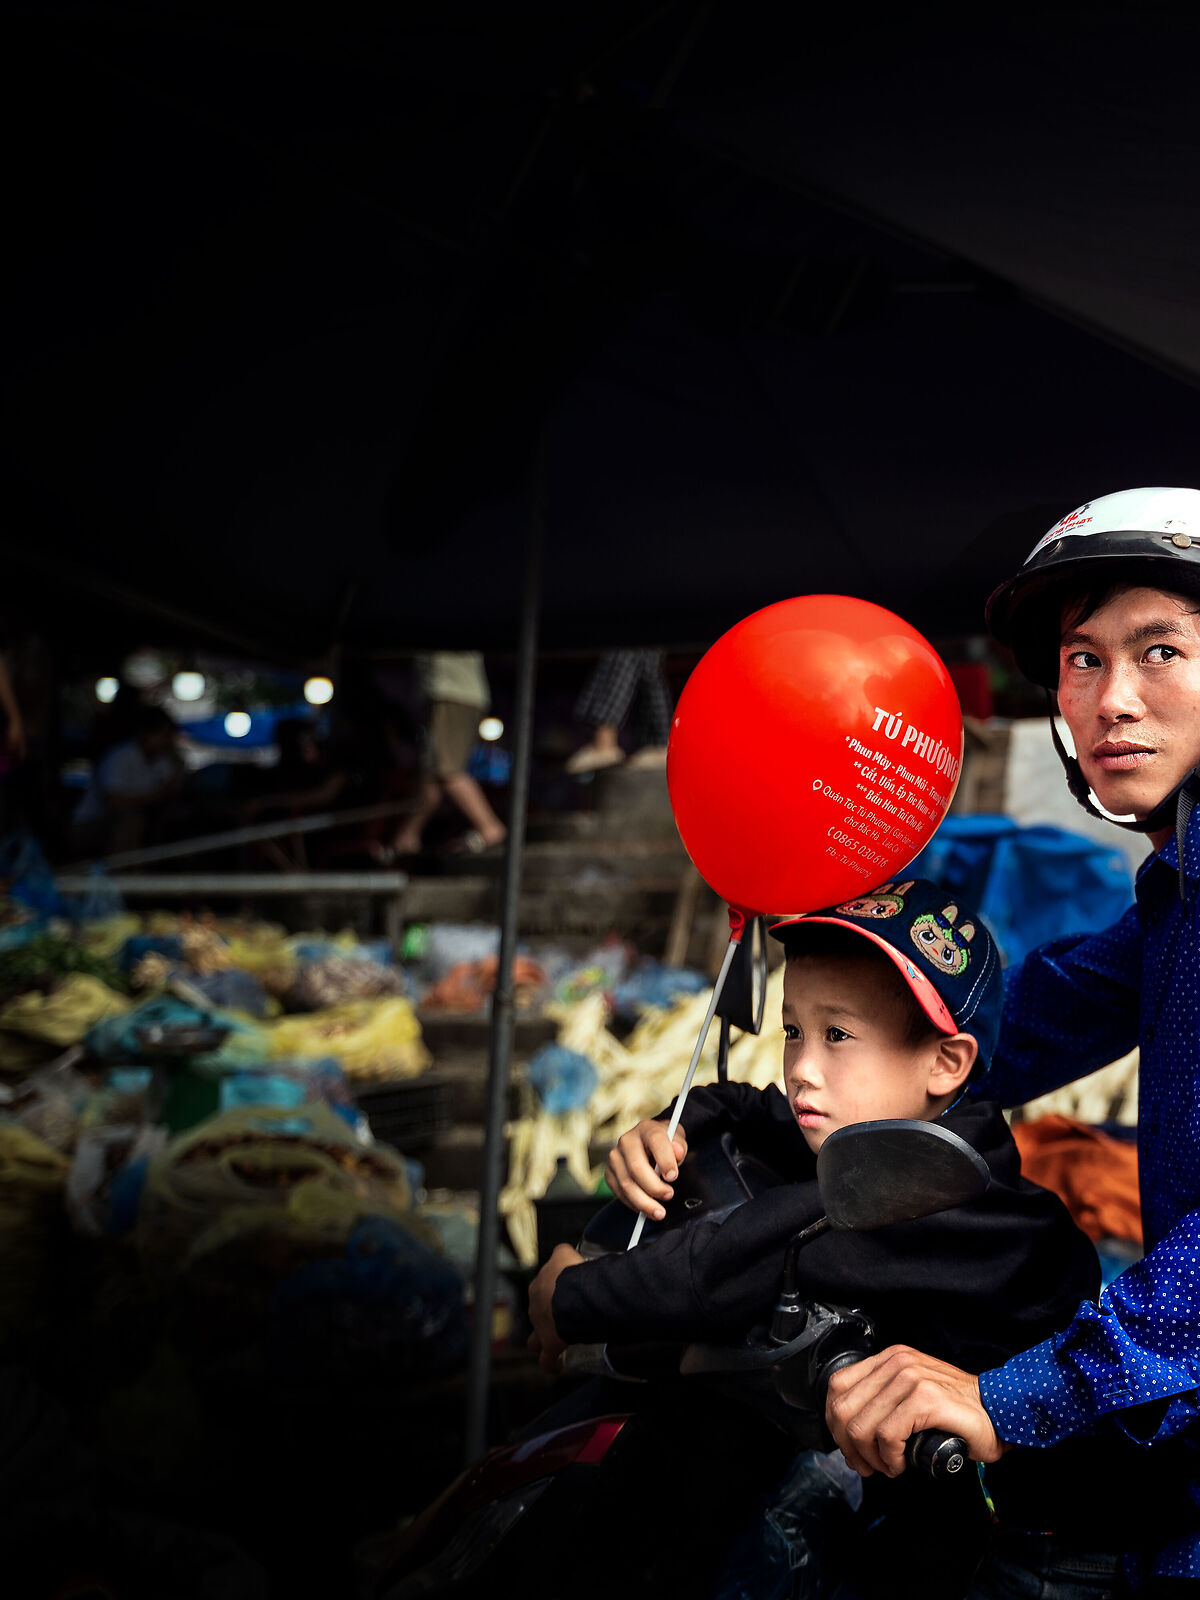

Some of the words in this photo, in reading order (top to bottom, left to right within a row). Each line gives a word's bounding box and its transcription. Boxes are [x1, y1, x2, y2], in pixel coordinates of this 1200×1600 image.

[848, 737, 873, 759] Phun
[871, 751, 892, 771] Mày
[895, 764, 916, 784] Phun
[871, 707, 904, 740] TÚ
[900, 724, 960, 783] PHƯỢNG
[822, 785, 844, 804] Quán
[843, 797, 858, 812] Tóc
[856, 805, 868, 818] Tú
[860, 765, 878, 785] Cắt,
[878, 775, 896, 795] Uốn,
[895, 783, 907, 801] Ép
[905, 791, 918, 806] Tóc
[881, 798, 898, 815] Hoa
[896, 807, 910, 821] Tai
[832, 830, 860, 850] 0865
[857, 845, 876, 860] 030
[872, 855, 889, 868] 616
